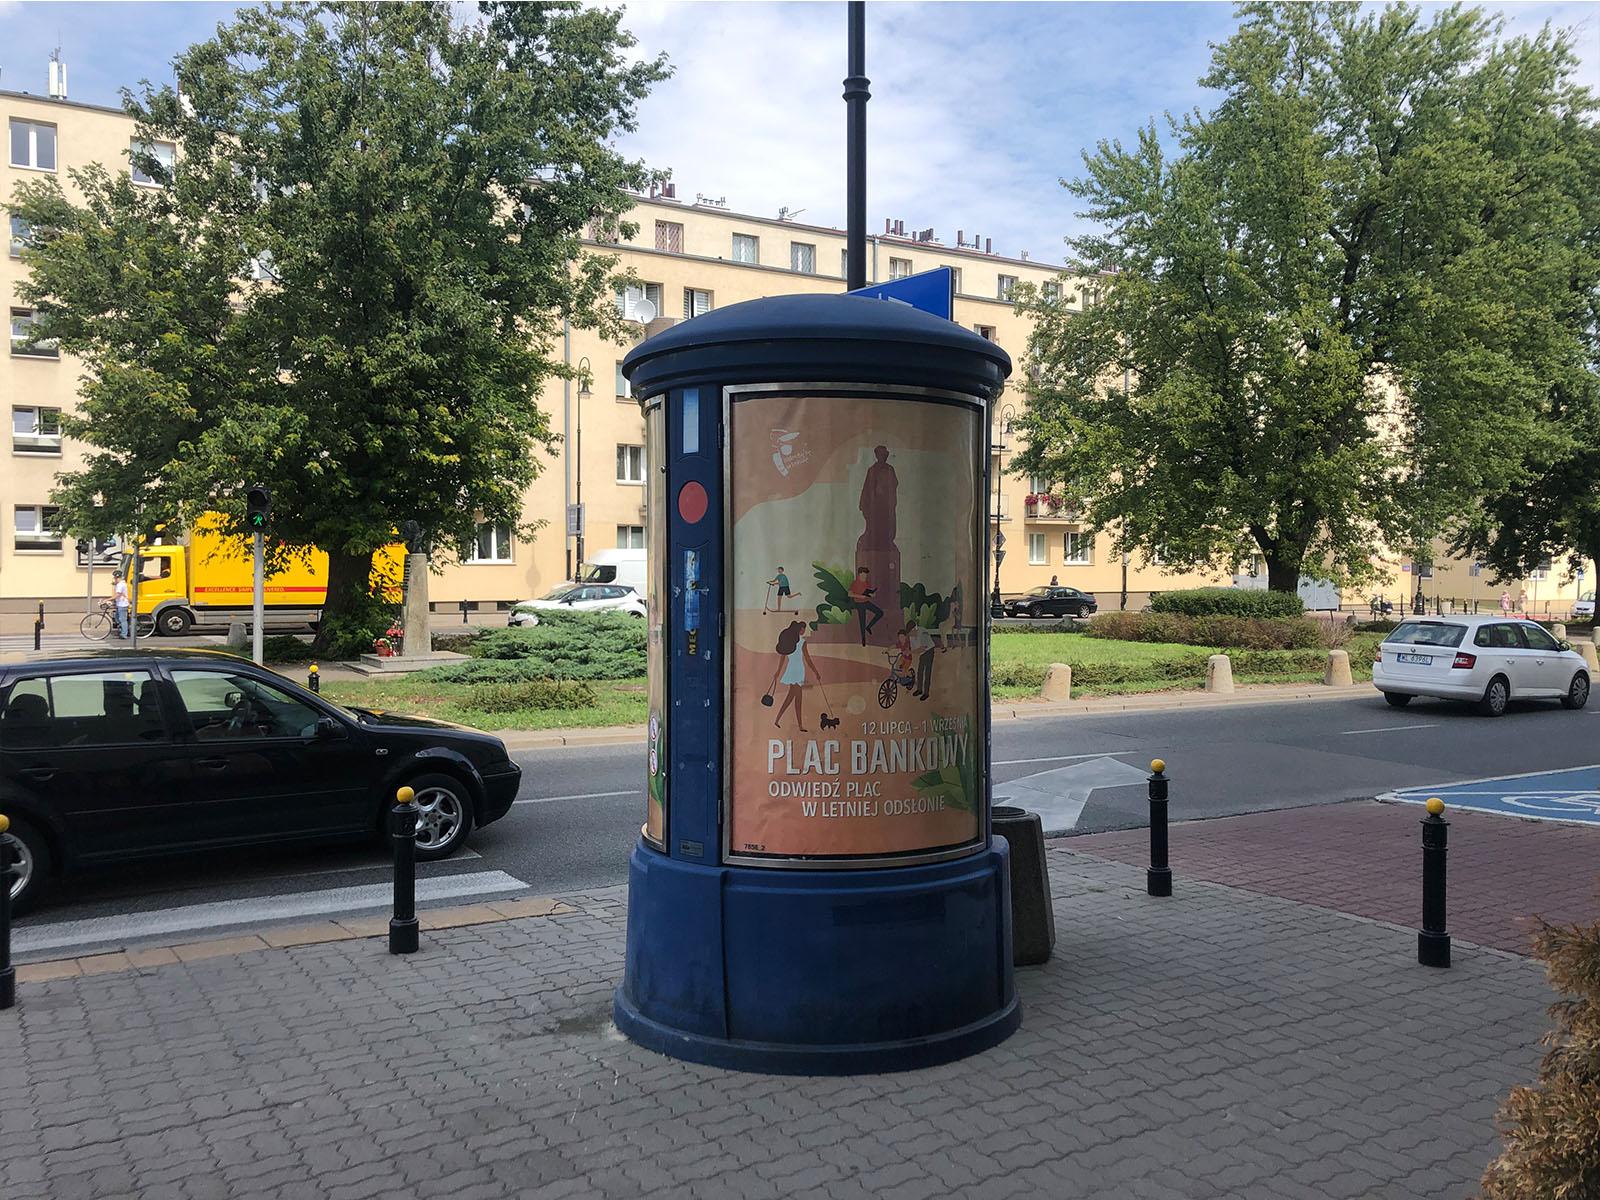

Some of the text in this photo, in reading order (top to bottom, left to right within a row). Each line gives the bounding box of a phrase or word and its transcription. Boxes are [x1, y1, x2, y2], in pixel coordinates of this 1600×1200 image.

[861, 720, 877, 735] 12
[880, 720, 912, 735] LIPCA
[921, 719, 928, 733] 1
[929, 714, 968, 732] WRZEŚNIA
[767, 733, 969, 775] PLAC BANKOWY
[768, 777, 881, 798] ODWIEDŹ PLAC
[801, 794, 945, 817] W LETNIEJ ODSŁONIE
